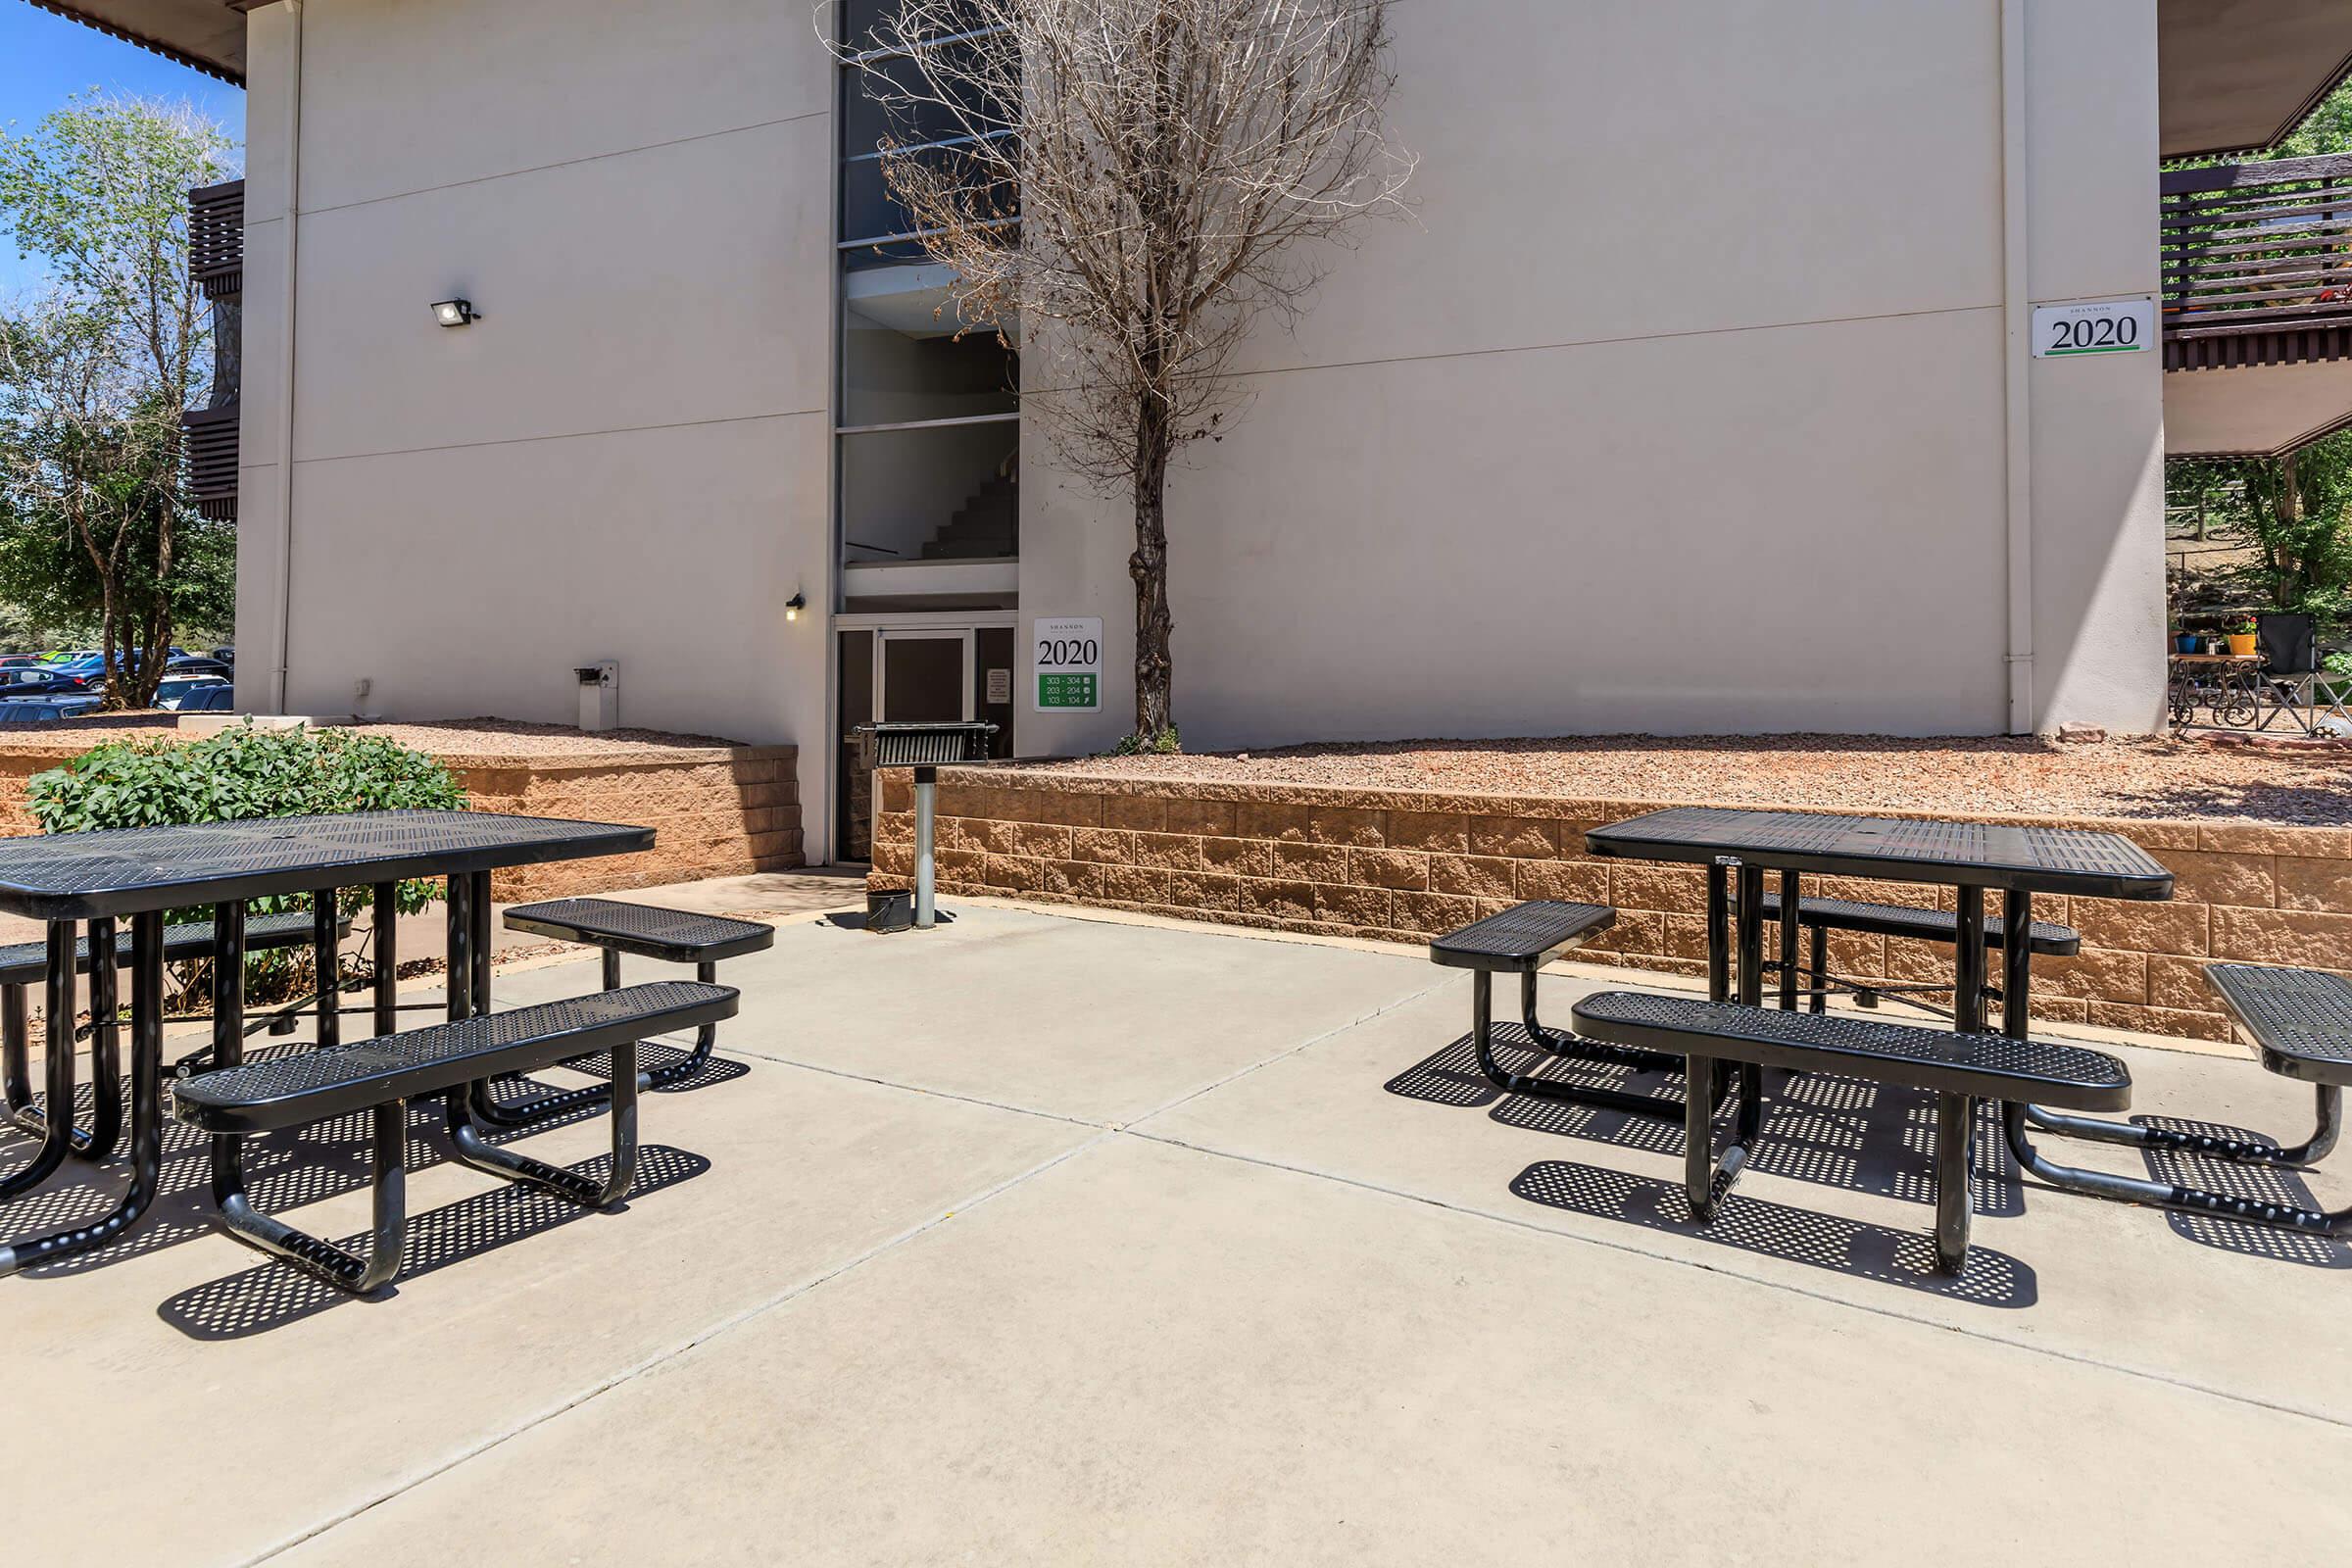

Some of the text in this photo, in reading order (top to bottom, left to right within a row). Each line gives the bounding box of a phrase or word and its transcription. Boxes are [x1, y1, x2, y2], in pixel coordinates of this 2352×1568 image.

[2051, 316, 2137, 349] 2020
[1038, 639, 1098, 665] 2020
[1047, 676, 1060, 685] 303
[1067, 676, 1081, 685] 304
[1047, 686, 1060, 695] 203
[1067, 686, 1081, 695] 204
[1048, 696, 1060, 705] 103
[1068, 696, 1080, 705] 104
